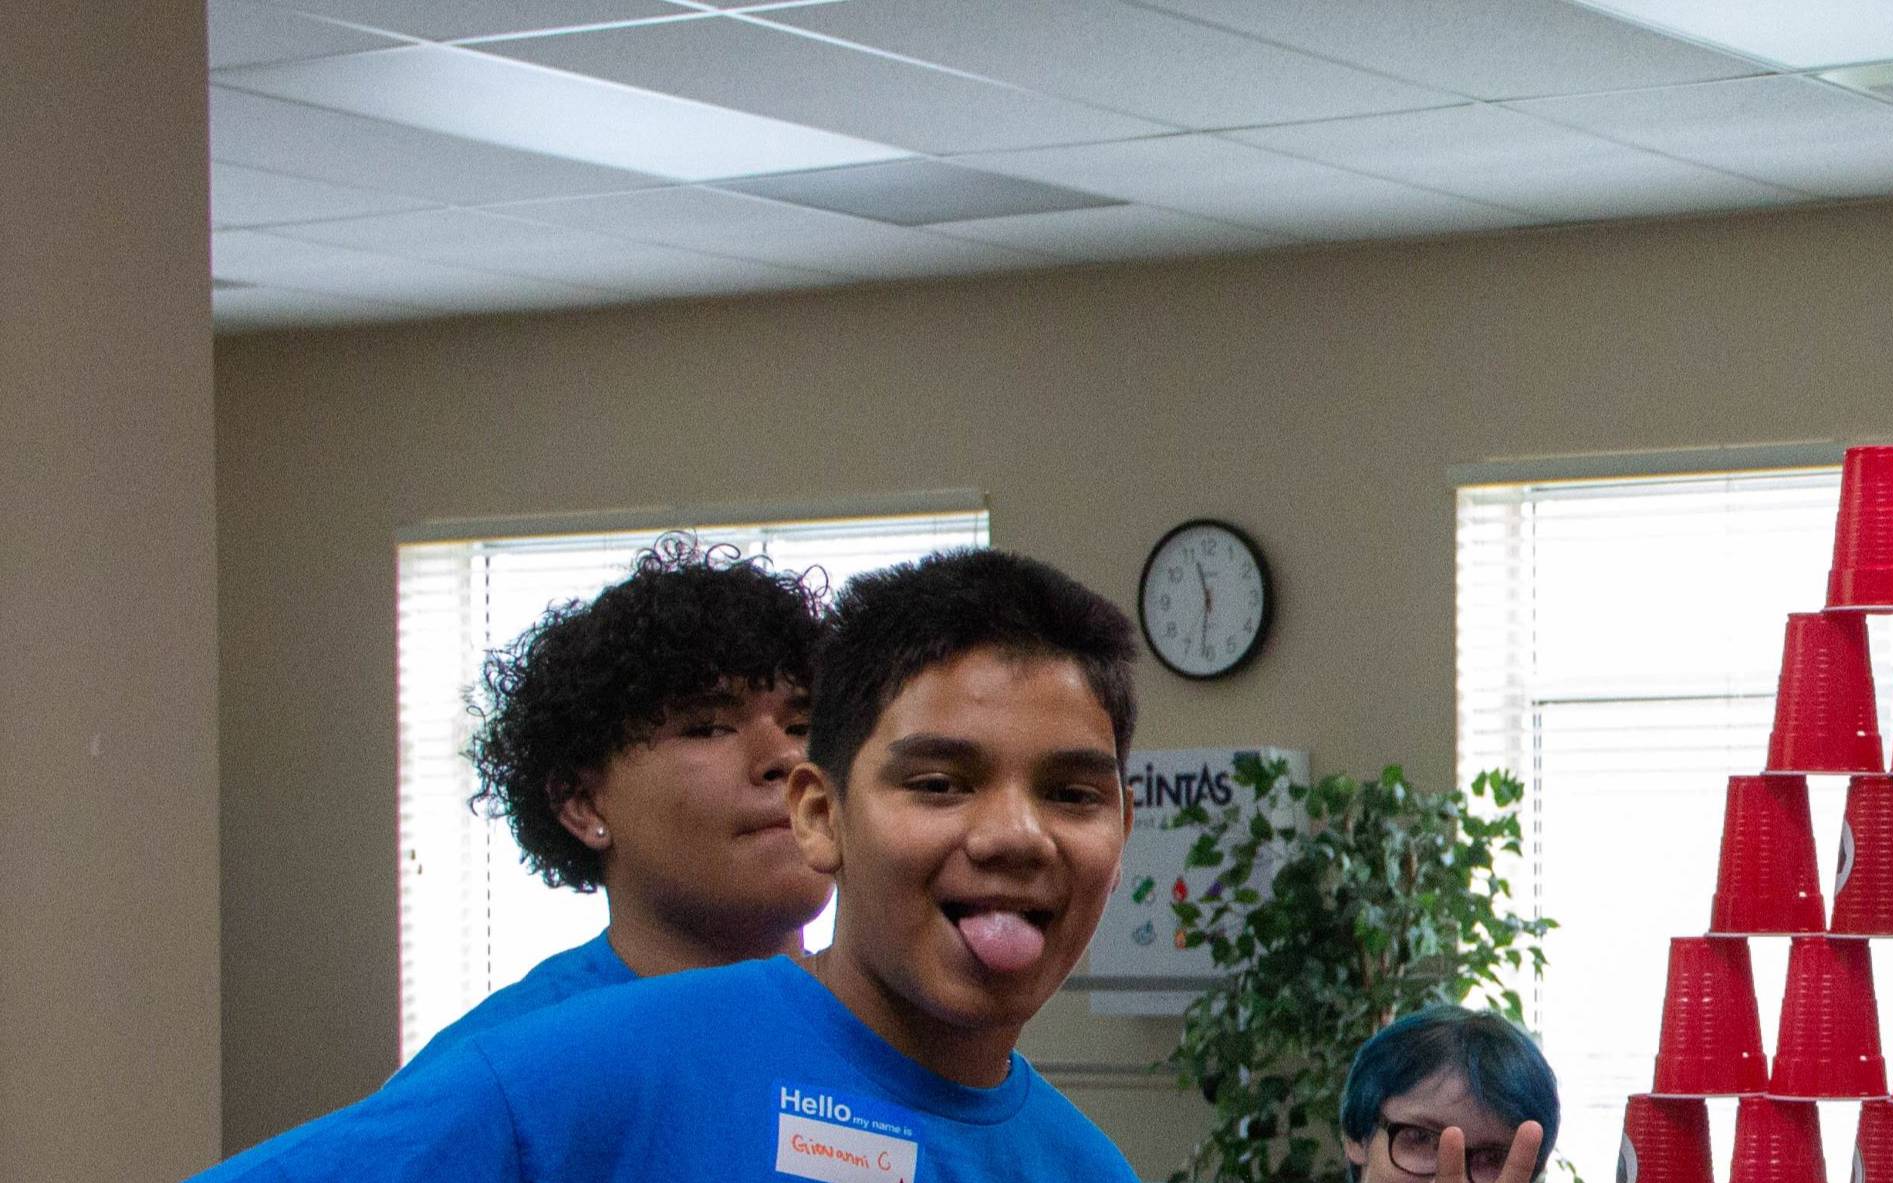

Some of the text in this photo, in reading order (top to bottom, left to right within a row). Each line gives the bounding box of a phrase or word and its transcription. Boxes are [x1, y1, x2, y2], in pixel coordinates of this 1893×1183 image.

[1183, 548, 1195, 562] 11
[1201, 538, 1217, 556] 12
[1168, 565, 1184, 584] 10
[1241, 562, 1252, 580] 2
[1160, 593, 1171, 611] 9
[1249, 590, 1259, 607] 3
[1166, 621, 1178, 638] 8
[1243, 617, 1253, 634] 4
[1183, 637, 1191, 654] 7
[1226, 635, 1237, 654] 5
[781, 1086, 913, 1137] Hello my name is
[791, 1133, 892, 1171] Giovanni C
